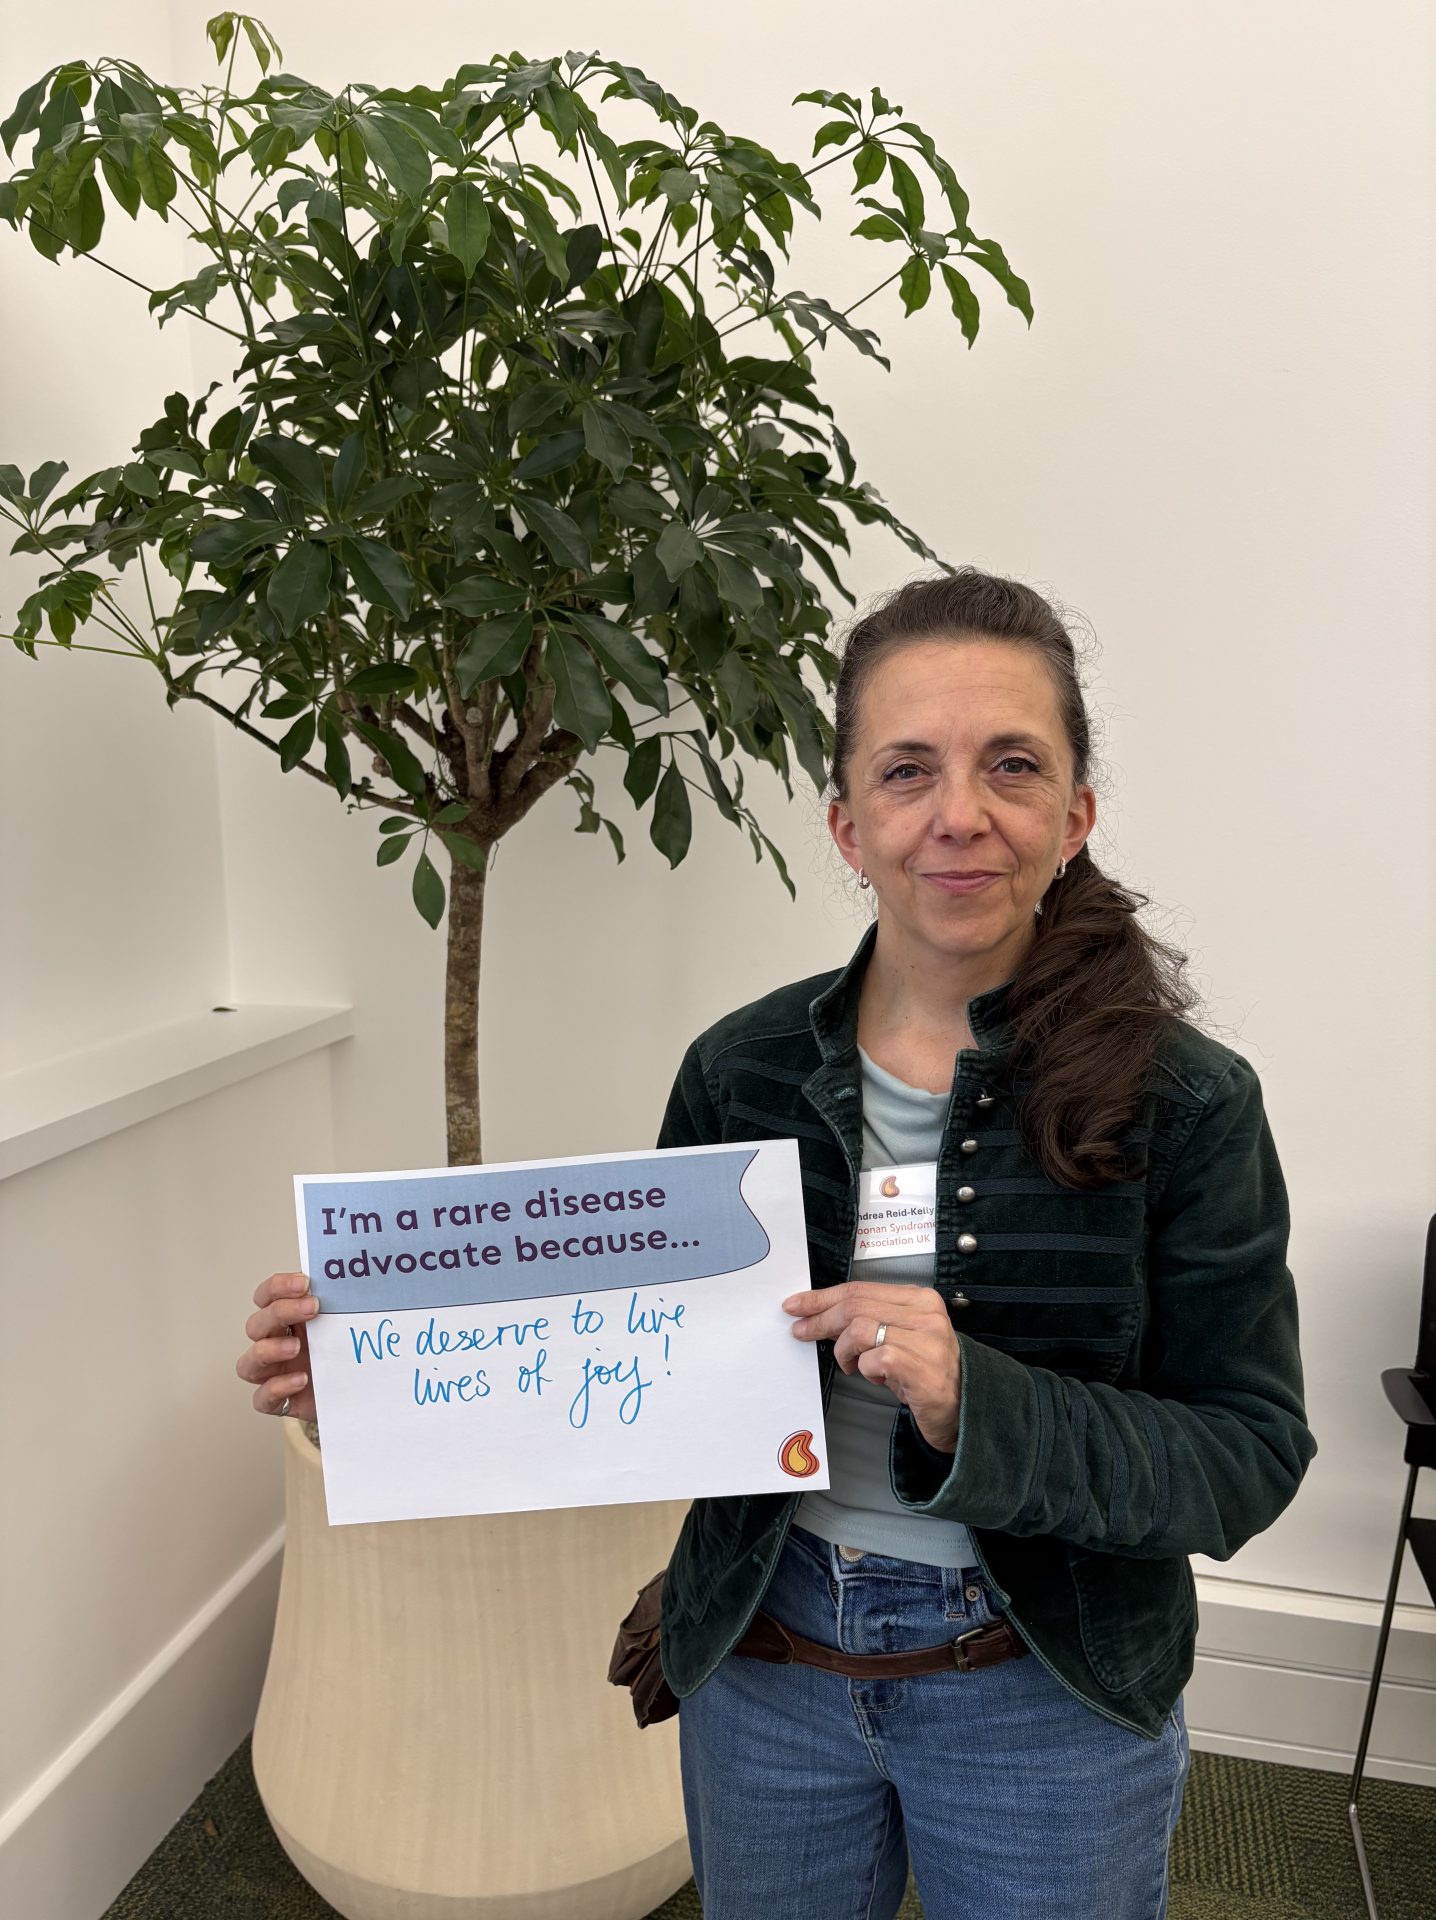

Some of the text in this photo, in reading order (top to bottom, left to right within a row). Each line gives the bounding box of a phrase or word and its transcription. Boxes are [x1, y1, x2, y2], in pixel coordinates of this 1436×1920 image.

[322, 1186, 667, 1235] I’m a rare disease
[856, 1225, 887, 1236] oonan
[857, 1206, 935, 1221] ndrea Reid-Kelly
[324, 1229, 701, 1280] advocate because...
[860, 1234, 931, 1249] Association UK
[349, 1291, 687, 1364] We deserve to live
[413, 1366, 492, 1407] lives
[517, 1348, 554, 1396] of
